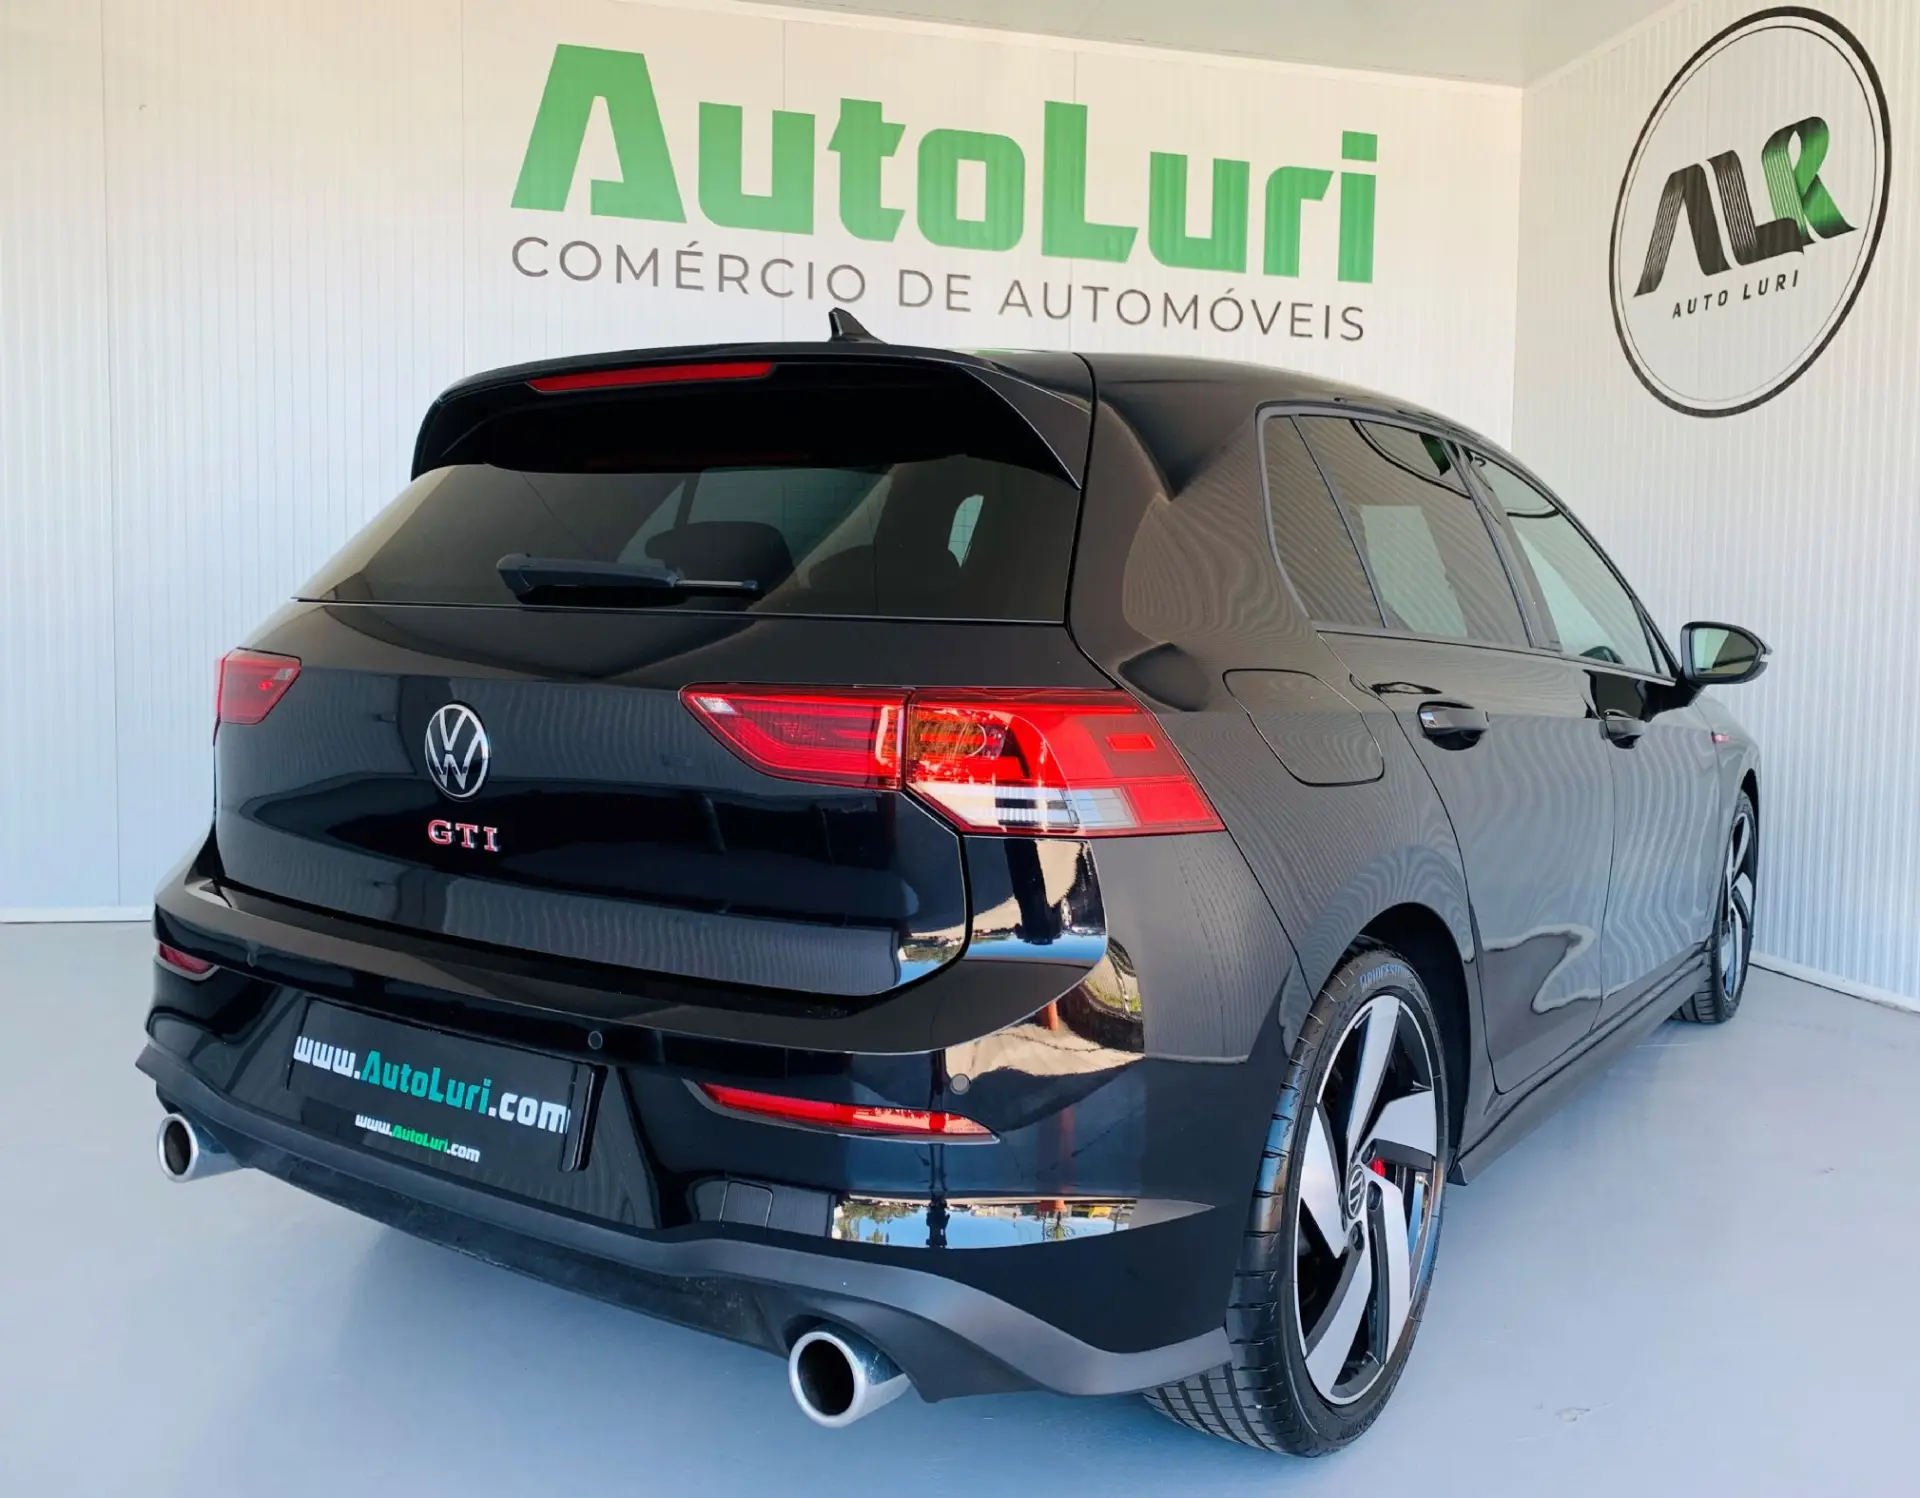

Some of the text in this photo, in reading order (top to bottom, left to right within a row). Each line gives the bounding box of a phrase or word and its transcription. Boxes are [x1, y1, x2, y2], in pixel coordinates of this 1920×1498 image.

[511, 44, 1378, 283] AutoLuri
[511, 236, 1364, 342] COMÉRCIO DE AUTOMÓVEIS
[1672, 269, 1799, 320] AUTO LURI
[428, 819, 499, 852] GTI
[293, 1035, 571, 1134] www.AutoLuri.com
[355, 1114, 480, 1163] www.AutoLuri.com
